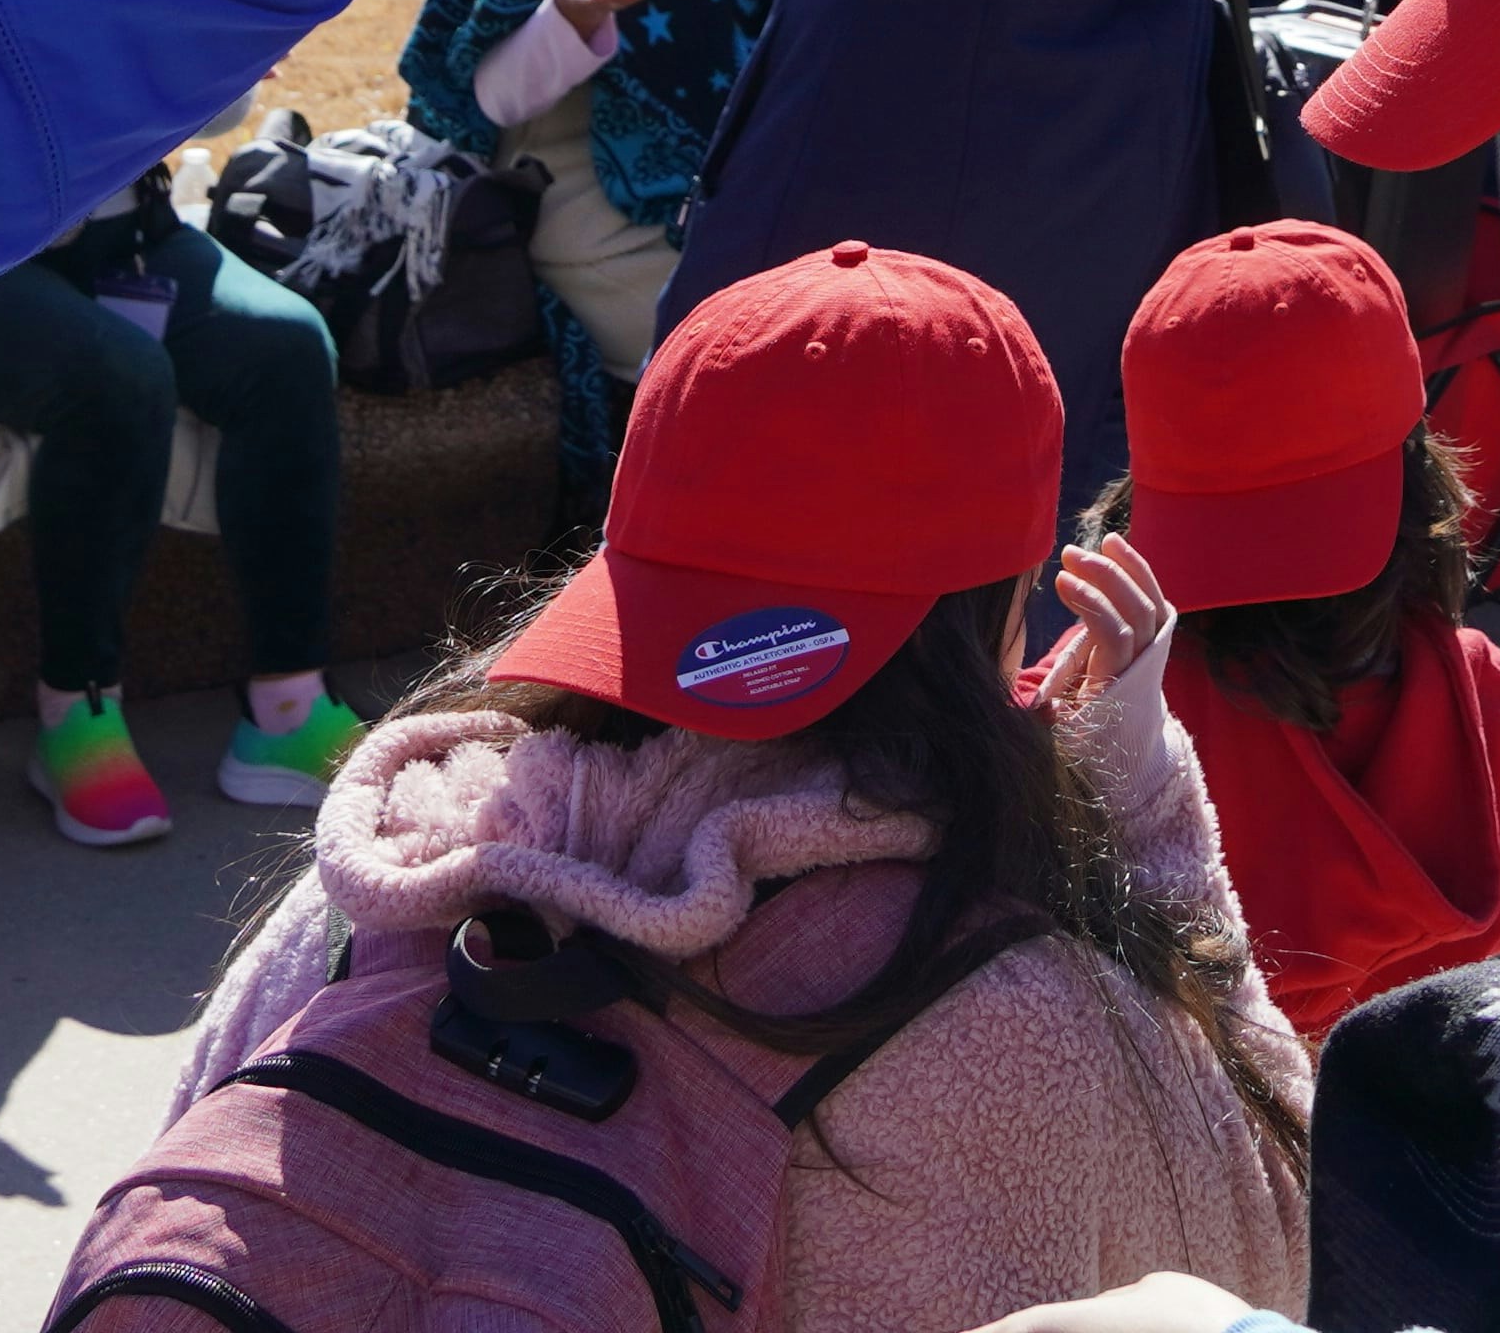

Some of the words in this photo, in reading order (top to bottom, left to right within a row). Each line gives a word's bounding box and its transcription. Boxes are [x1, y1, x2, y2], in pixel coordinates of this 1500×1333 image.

[695, 619, 817, 661] Champion
[693, 659, 742, 682] AUTHENTIC
[743, 642, 807, 667] ATHLETICWEAR
